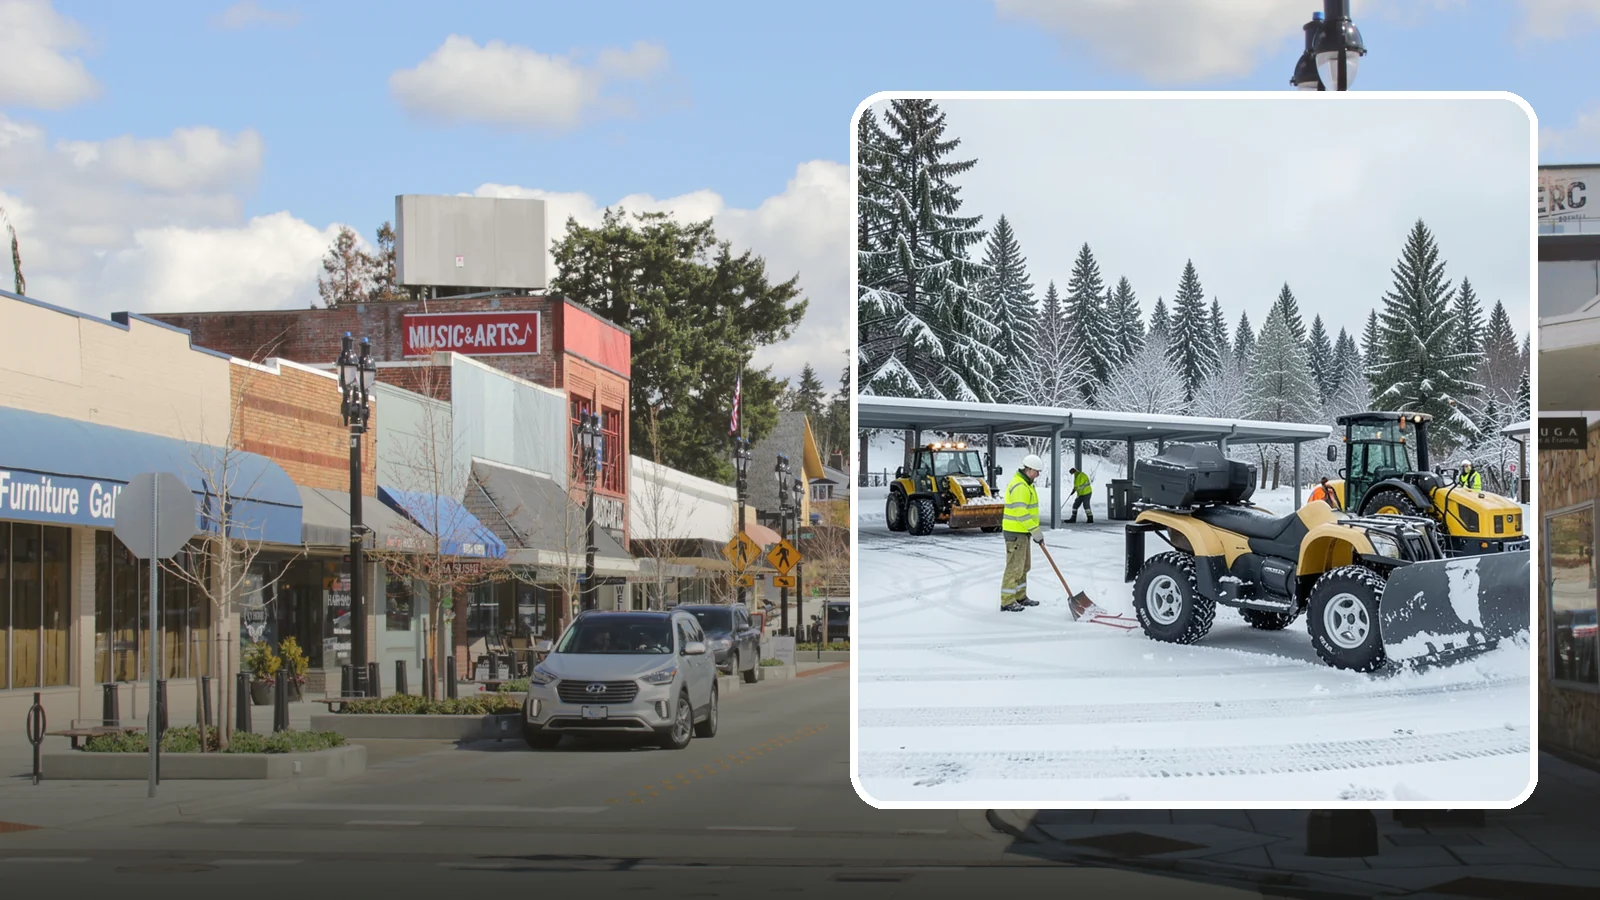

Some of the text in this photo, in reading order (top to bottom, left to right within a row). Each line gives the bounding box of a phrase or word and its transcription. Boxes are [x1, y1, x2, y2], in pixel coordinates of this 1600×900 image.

[1540, 427, 1577, 436] UGA
[0, 472, 121, 519] Furniture Gal
